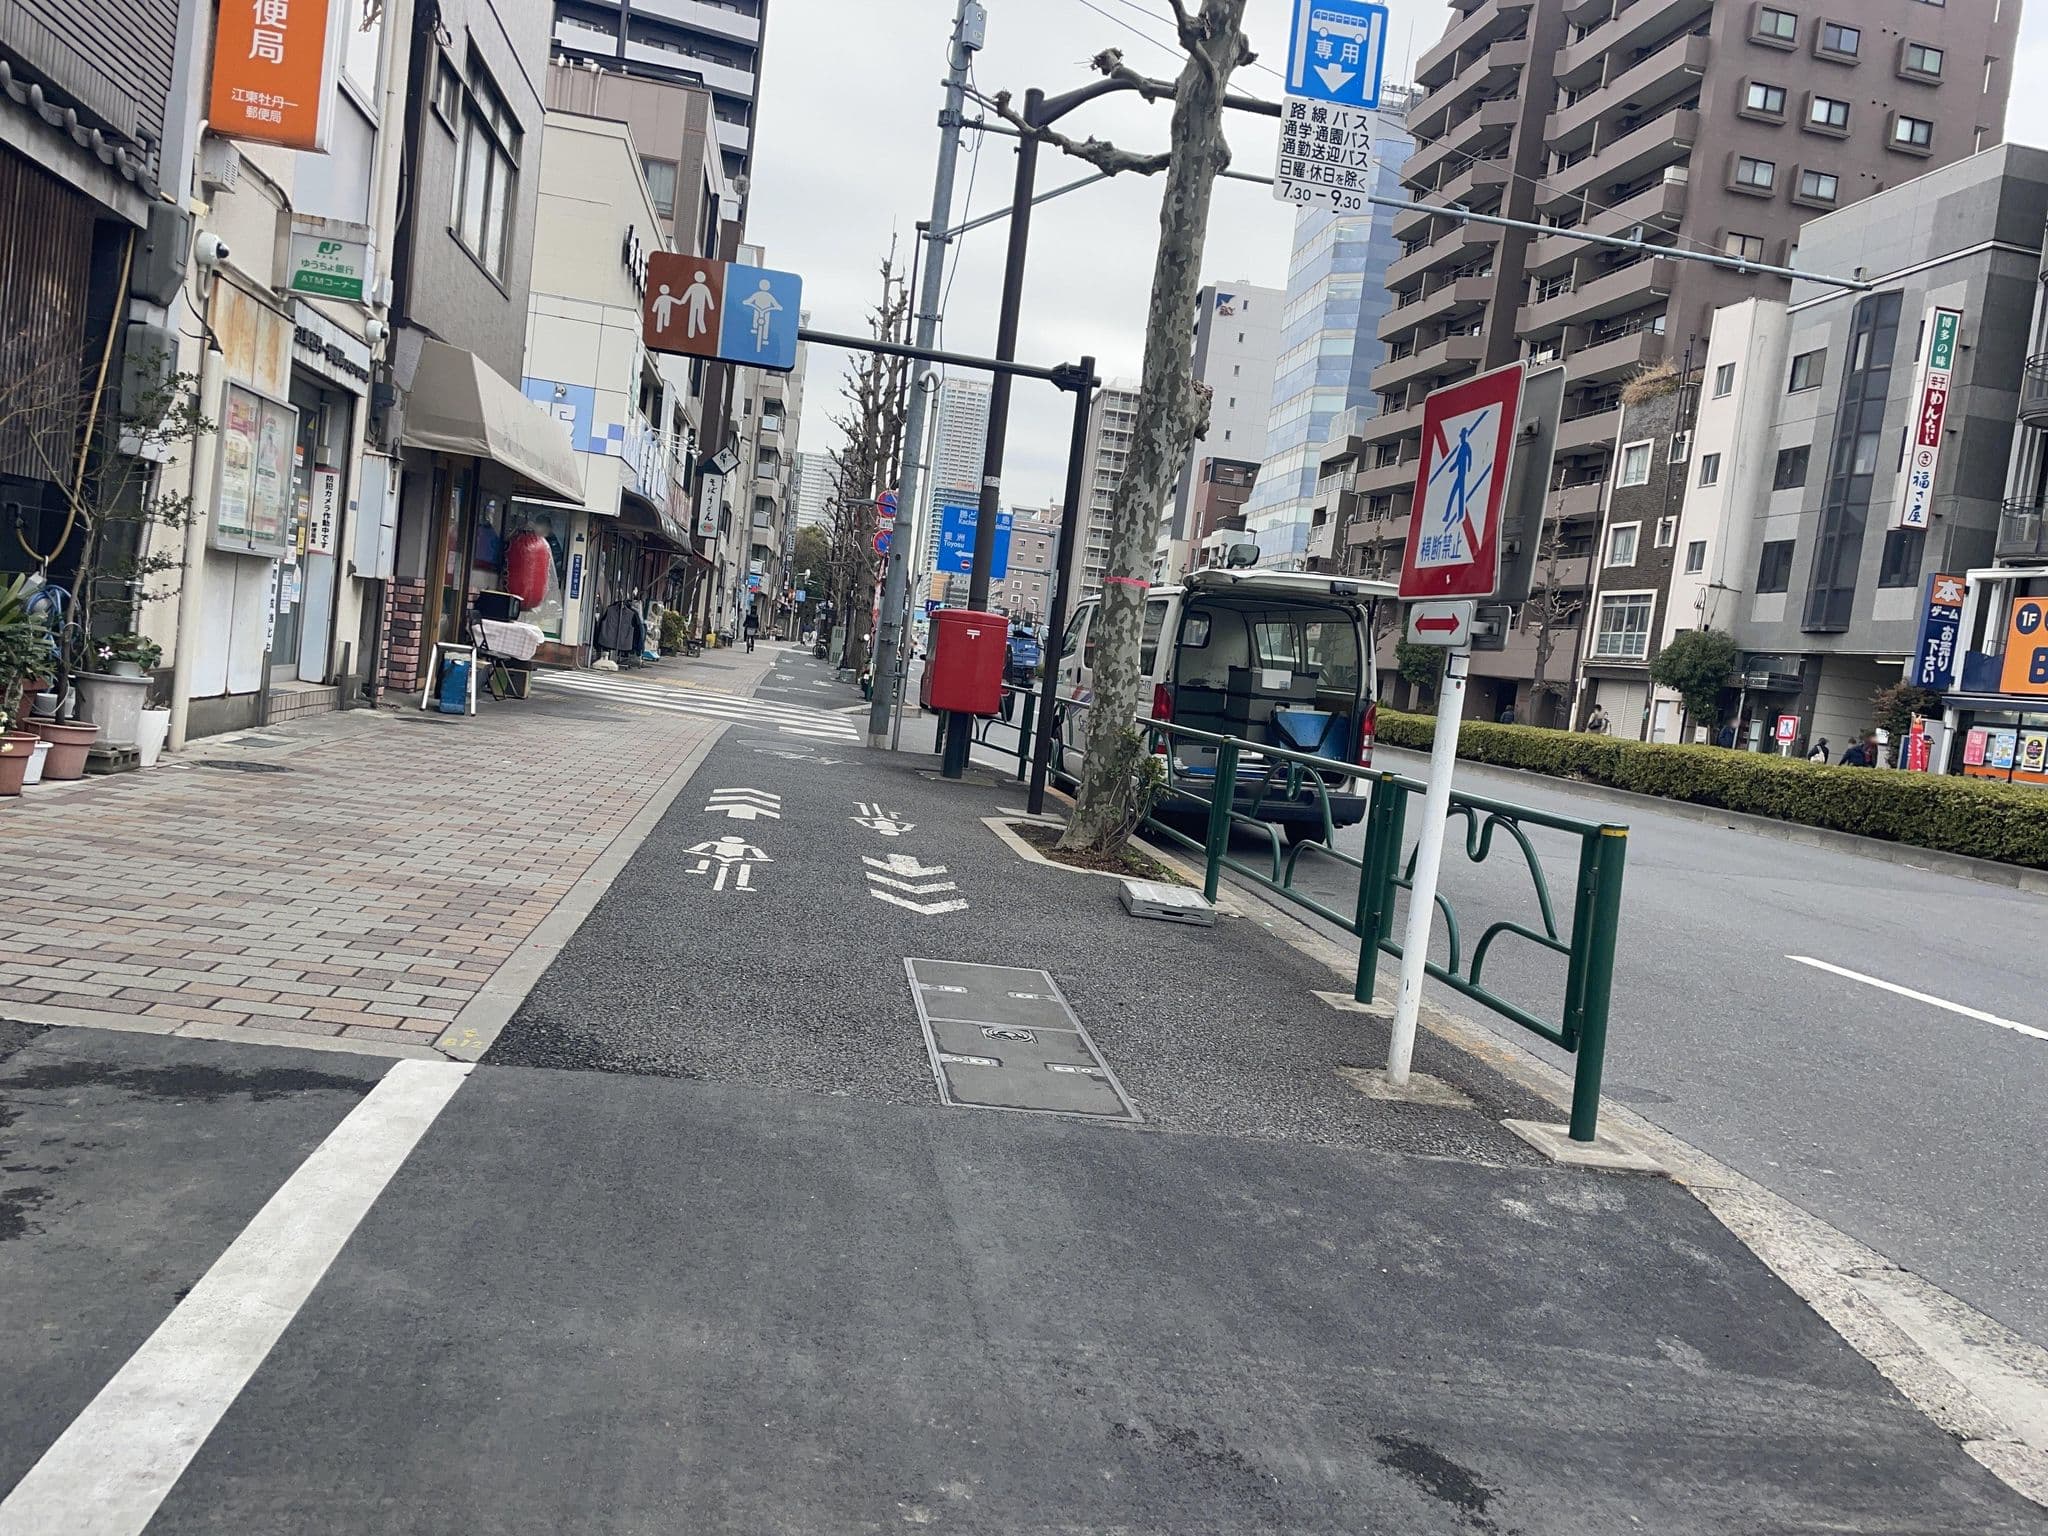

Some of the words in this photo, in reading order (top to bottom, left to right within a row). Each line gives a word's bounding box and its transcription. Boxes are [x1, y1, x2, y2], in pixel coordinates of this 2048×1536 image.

[1315, 39, 1360, 65] 専用
[231, 87, 299, 109] 江東牡丹一
[245, 105, 282, 124] 郵便局
[1290, 102, 1369, 132] 路線バス
[1281, 138, 1368, 168] 通勤送迎バス
[318, 241, 342, 254] JP
[301, 258, 354, 275] ゆうちょ銀行
[301, 275, 358, 288] ATMコーナー
[1936, 316, 1953, 368] 博多の味
[321, 475, 334, 549] 防犯カメラ作動中です
[944, 540, 965, 548] Toyosu
[1420, 531, 1464, 562] 横断禁止
[1935, 580, 1961, 602] 本
[1931, 605, 1958, 620] ゲーム
[2022, 611, 2038, 627] 1F
[1938, 625, 1954, 671] お売り
[1922, 639, 1940, 683] 下さい
